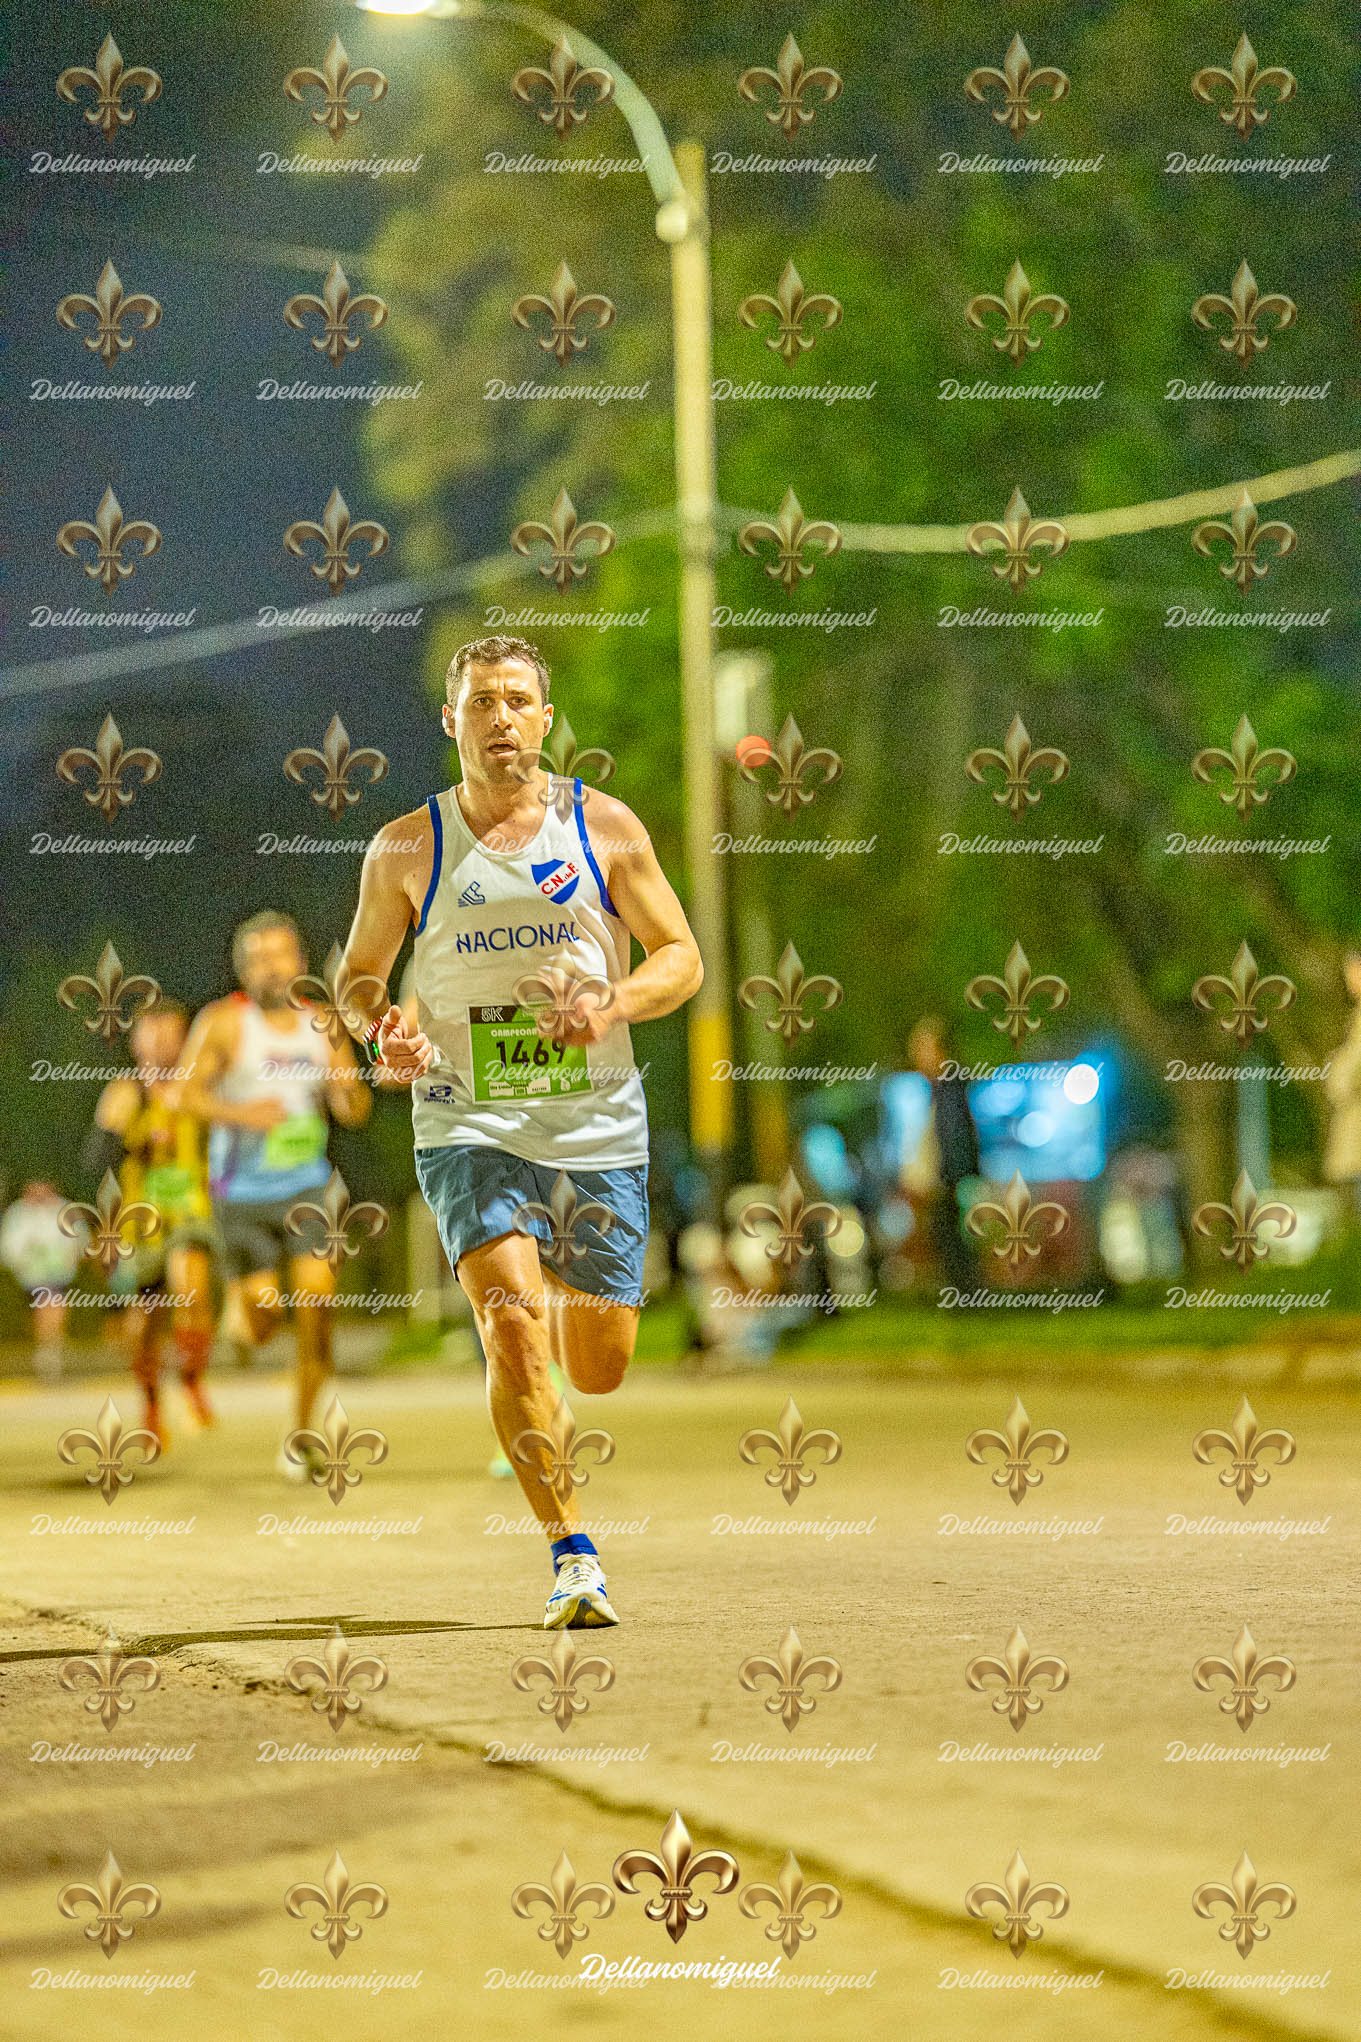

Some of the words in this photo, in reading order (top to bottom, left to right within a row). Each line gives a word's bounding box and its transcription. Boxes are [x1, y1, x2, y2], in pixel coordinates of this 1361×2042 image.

[456, 922, 580, 954] NACIONAL
[481, 1006, 504, 1022] 5K
[496, 1039, 566, 1069] 1469
